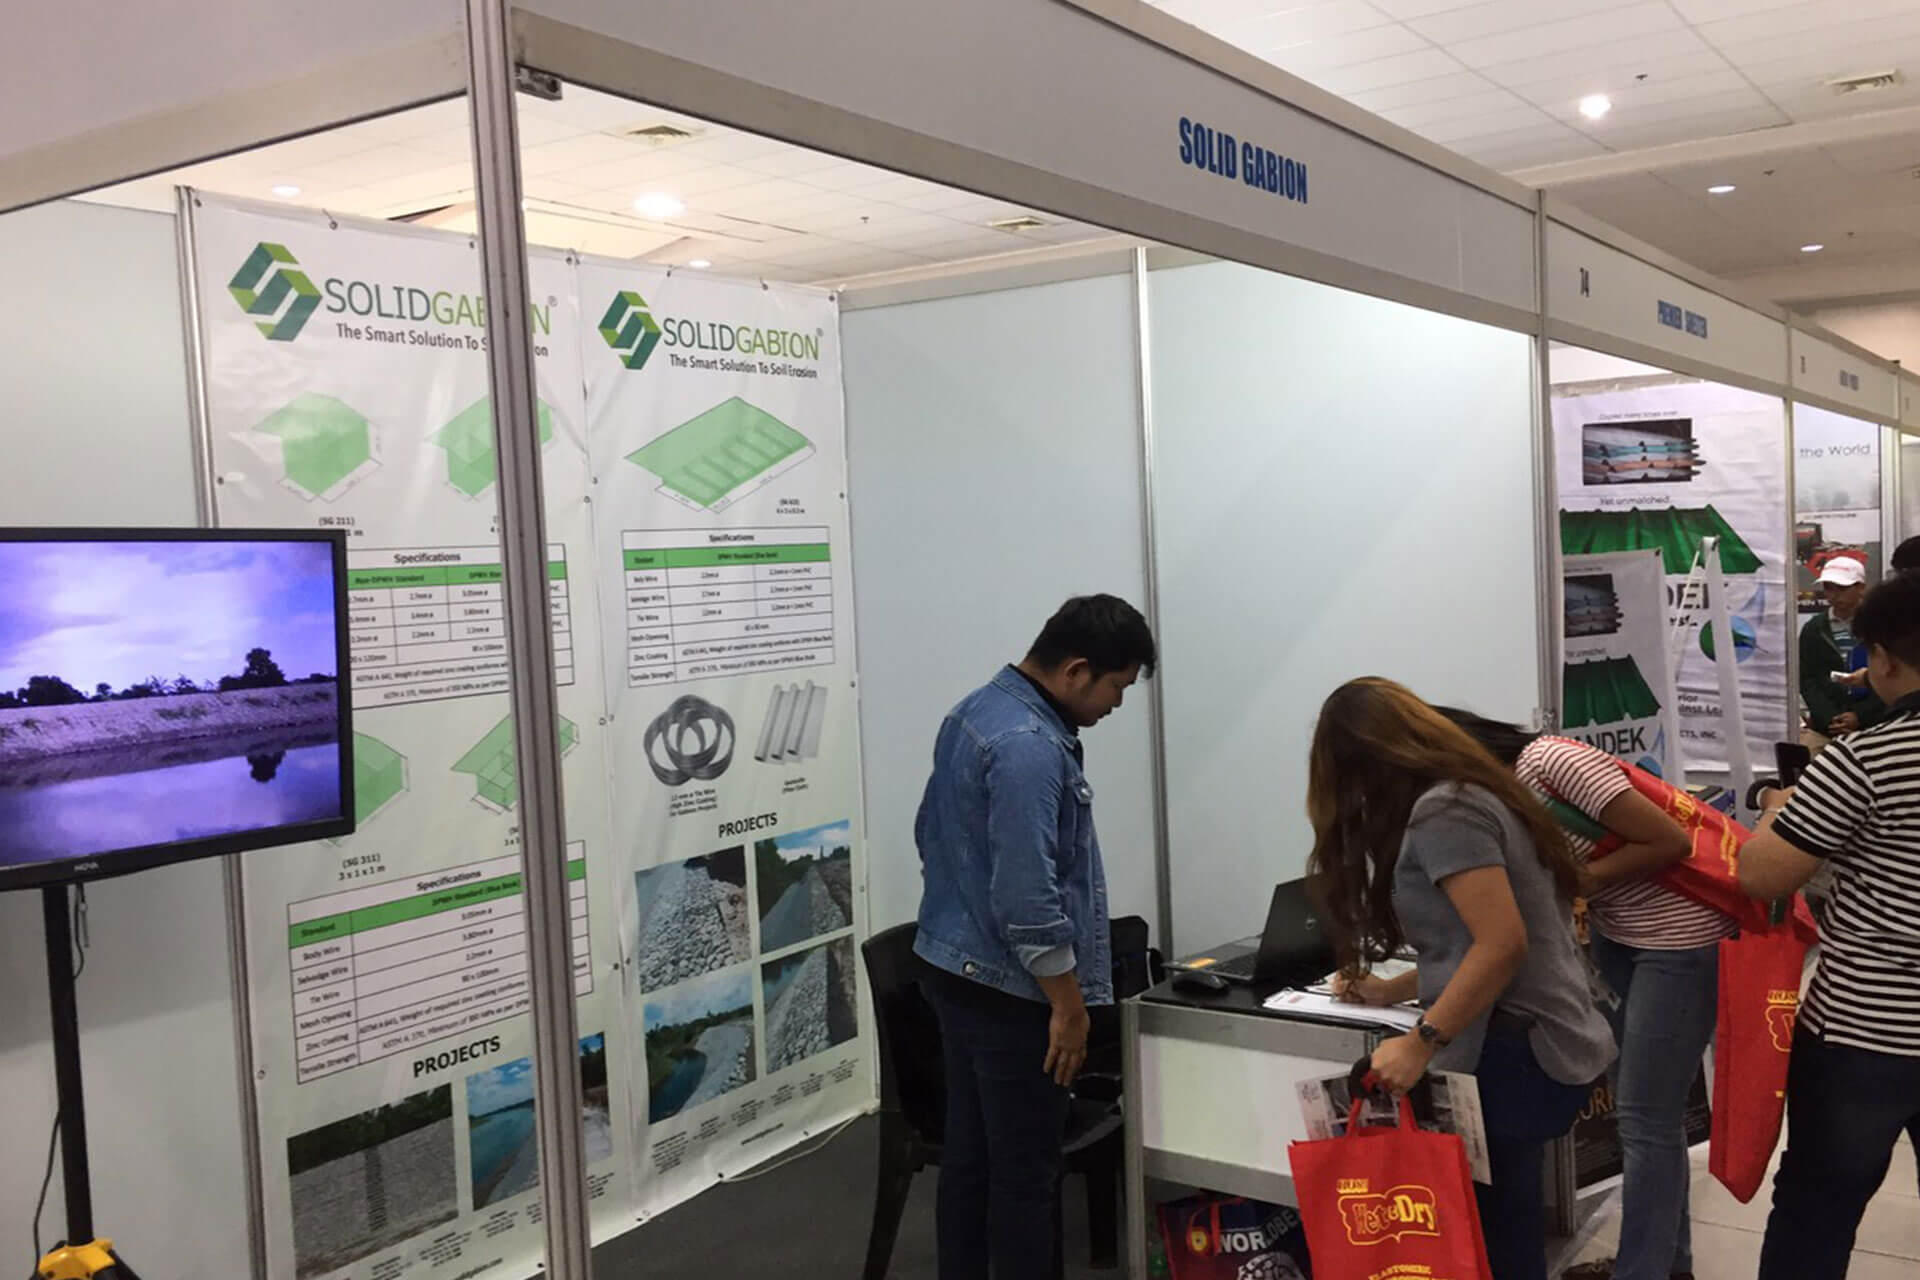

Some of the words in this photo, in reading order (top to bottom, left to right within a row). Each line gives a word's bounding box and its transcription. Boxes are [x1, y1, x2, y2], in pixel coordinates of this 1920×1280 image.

[1179, 116, 1237, 180] SOLID
[1242, 141, 1308, 205] GABION
[336, 323, 362, 340] The
[365, 326, 406, 345] Smart
[409, 329, 463, 350] Solution
[465, 335, 480, 351] To
[662, 317, 819, 361] SOLIDGABION
[670, 353, 688, 369] The
[690, 355, 718, 371] Smart
[720, 357, 757, 374] Solution
[759, 361, 769, 375] To
[771, 362, 788, 376] Soil
[788, 366, 818, 379] Erosion
[1800, 448, 1824, 458] the
[1828, 443, 1871, 457] World
[1616, 495, 1670, 505] unmatched
[709, 533, 755, 543] Specifications
[393, 552, 462, 565] Specifications
[1575, 727, 1647, 755] NDEK
[718, 811, 778, 839] PROJECTS
[360, 853, 381, 865] 311)
[376, 865, 386, 873] m
[416, 870, 482, 892] Specifications
[303, 951, 322, 961] Body
[323, 946, 341, 956] Wire
[330, 965, 349, 976] Wire
[310, 995, 321, 1004] Tie
[322, 991, 341, 1001] Wire
[300, 1018, 321, 1030] Mesh
[321, 1009, 352, 1025] Opening
[305, 1042, 321, 1052] Zinc
[321, 1033, 350, 1047] Coating
[300, 1062, 326, 1075] Tensile
[326, 1052, 357, 1067] Strength
[413, 1035, 502, 1078] PROJECTS
[1393, 1194, 1435, 1231] Dry
